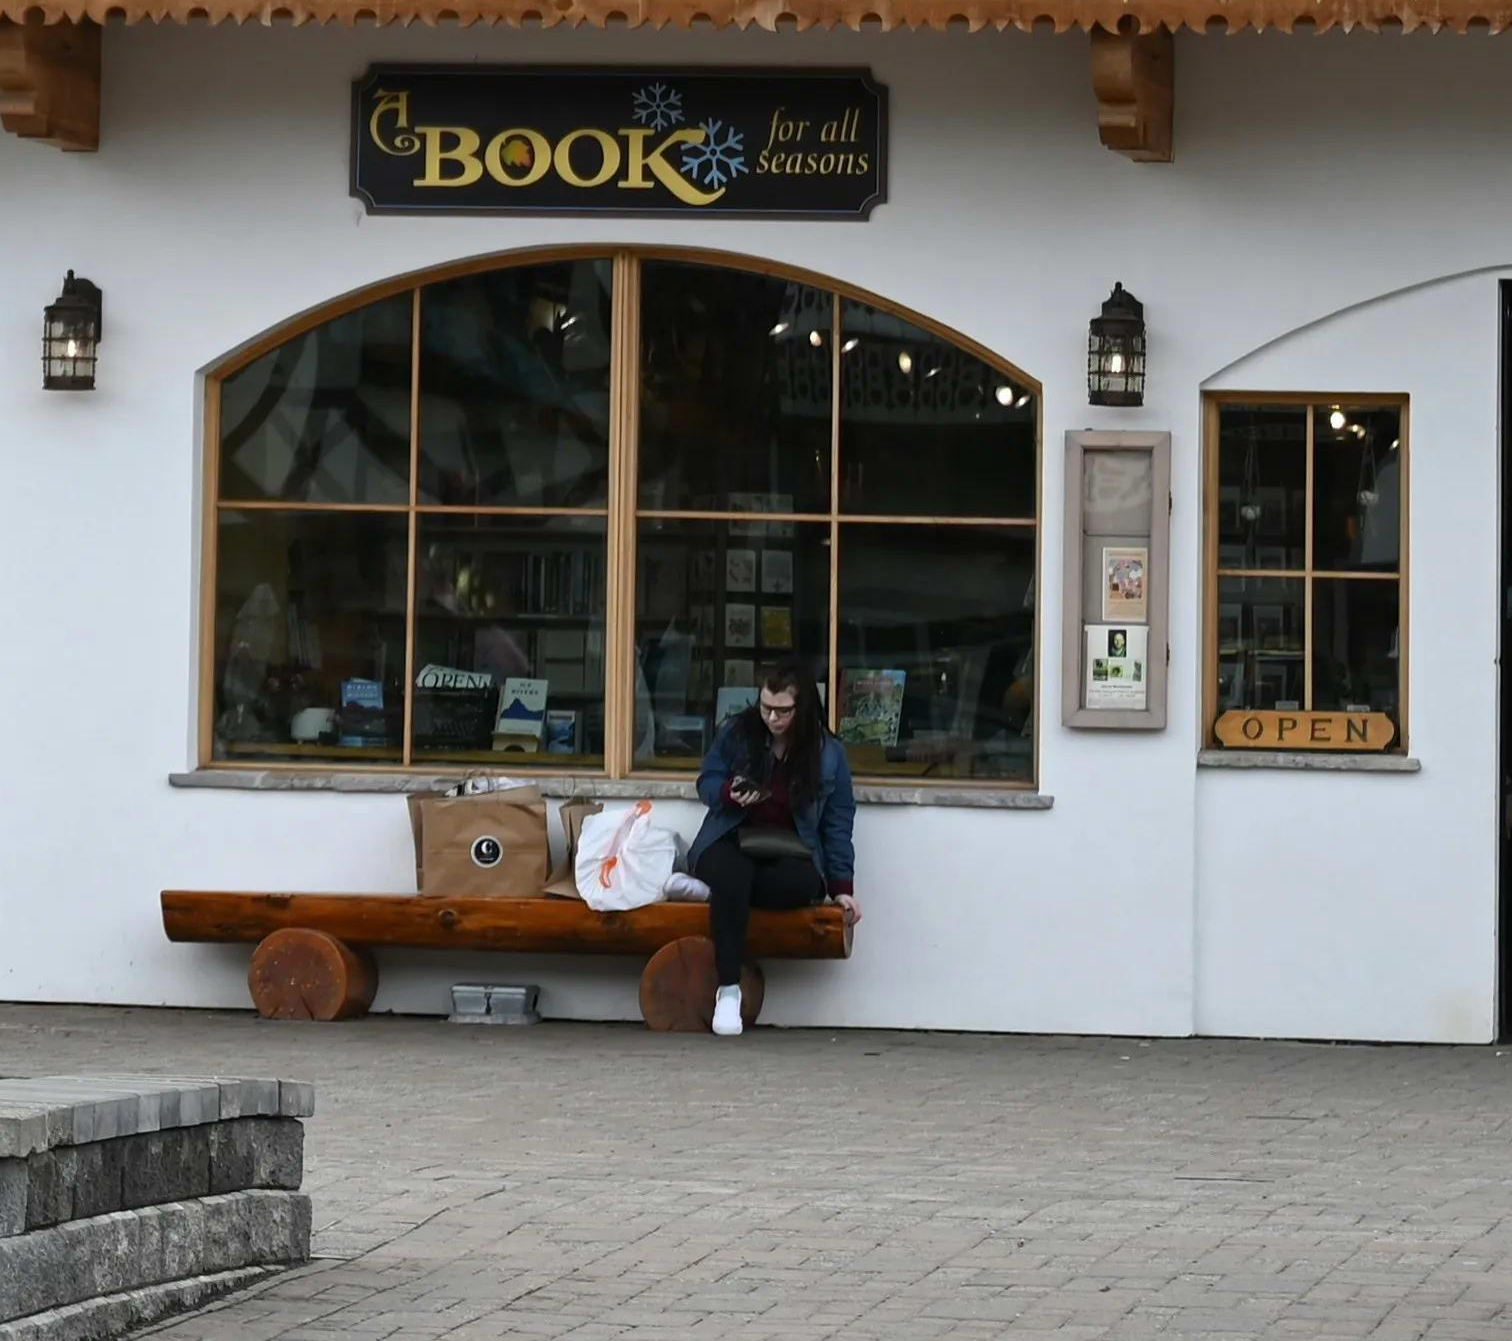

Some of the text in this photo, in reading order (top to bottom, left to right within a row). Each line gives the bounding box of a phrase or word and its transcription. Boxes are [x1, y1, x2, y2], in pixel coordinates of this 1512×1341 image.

[370, 88, 421, 156] A
[766, 106, 861, 153] for all
[413, 127, 726, 206] BOOK
[756, 148, 870, 175] seasons
[1242, 717, 1369, 743] OPEN
